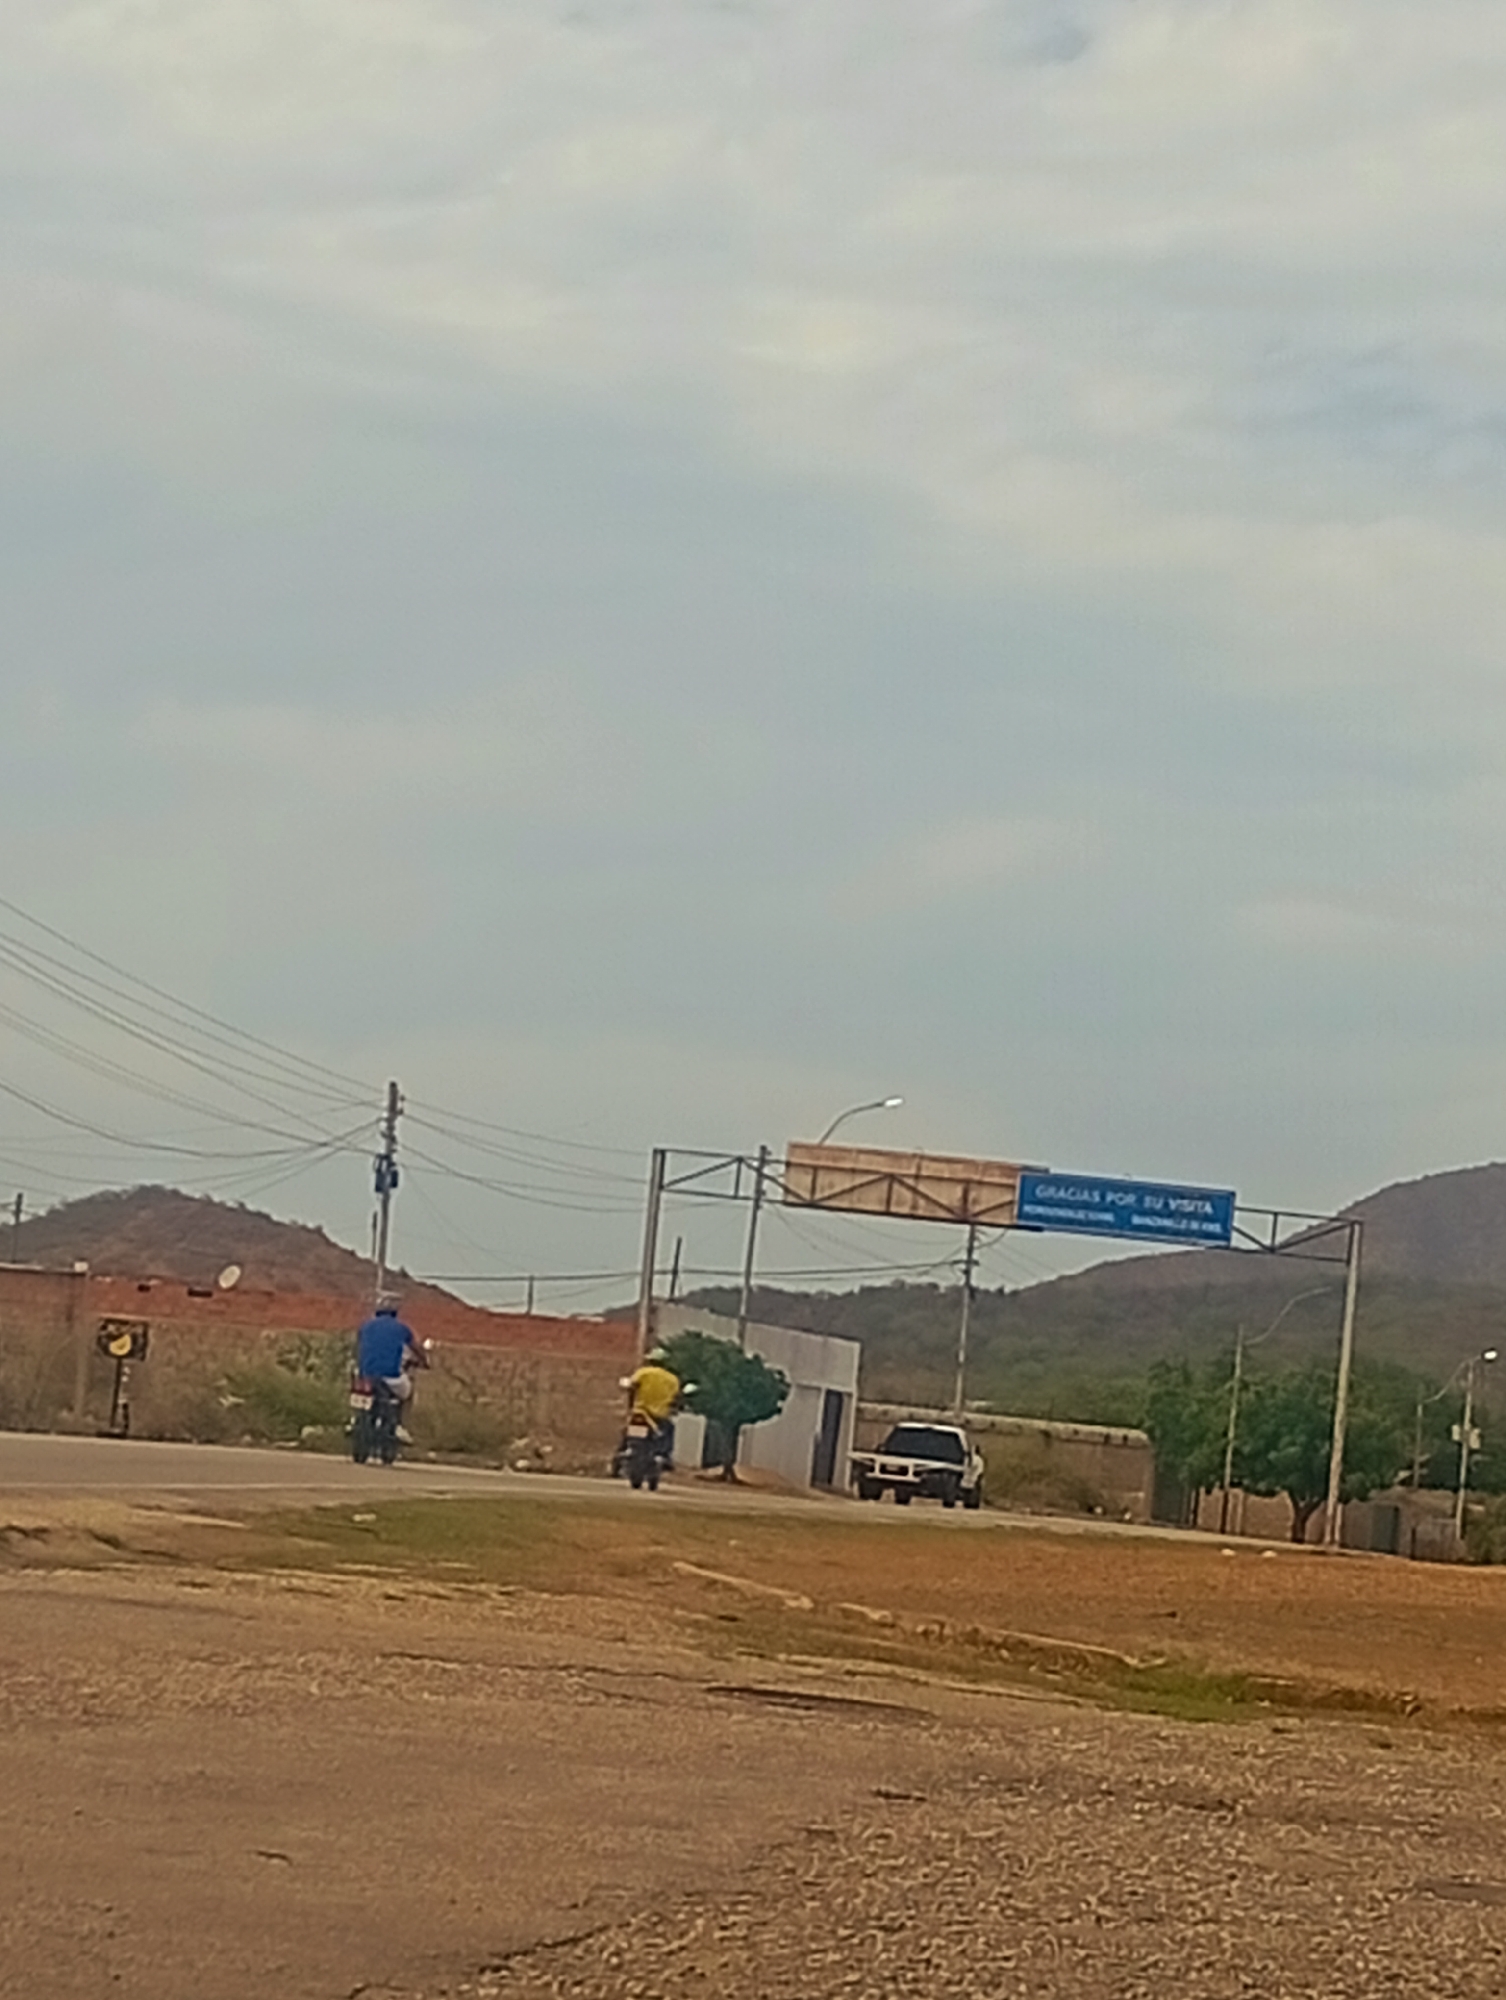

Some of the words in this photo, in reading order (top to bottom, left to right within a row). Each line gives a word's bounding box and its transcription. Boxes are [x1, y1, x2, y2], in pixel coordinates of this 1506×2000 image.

[1035, 1184, 1100, 1203] GRACIAS
[1106, 1191, 1137, 1207] POR
[1143, 1195, 1164, 1211] SU
[1168, 1198, 1214, 1215] VISITA
